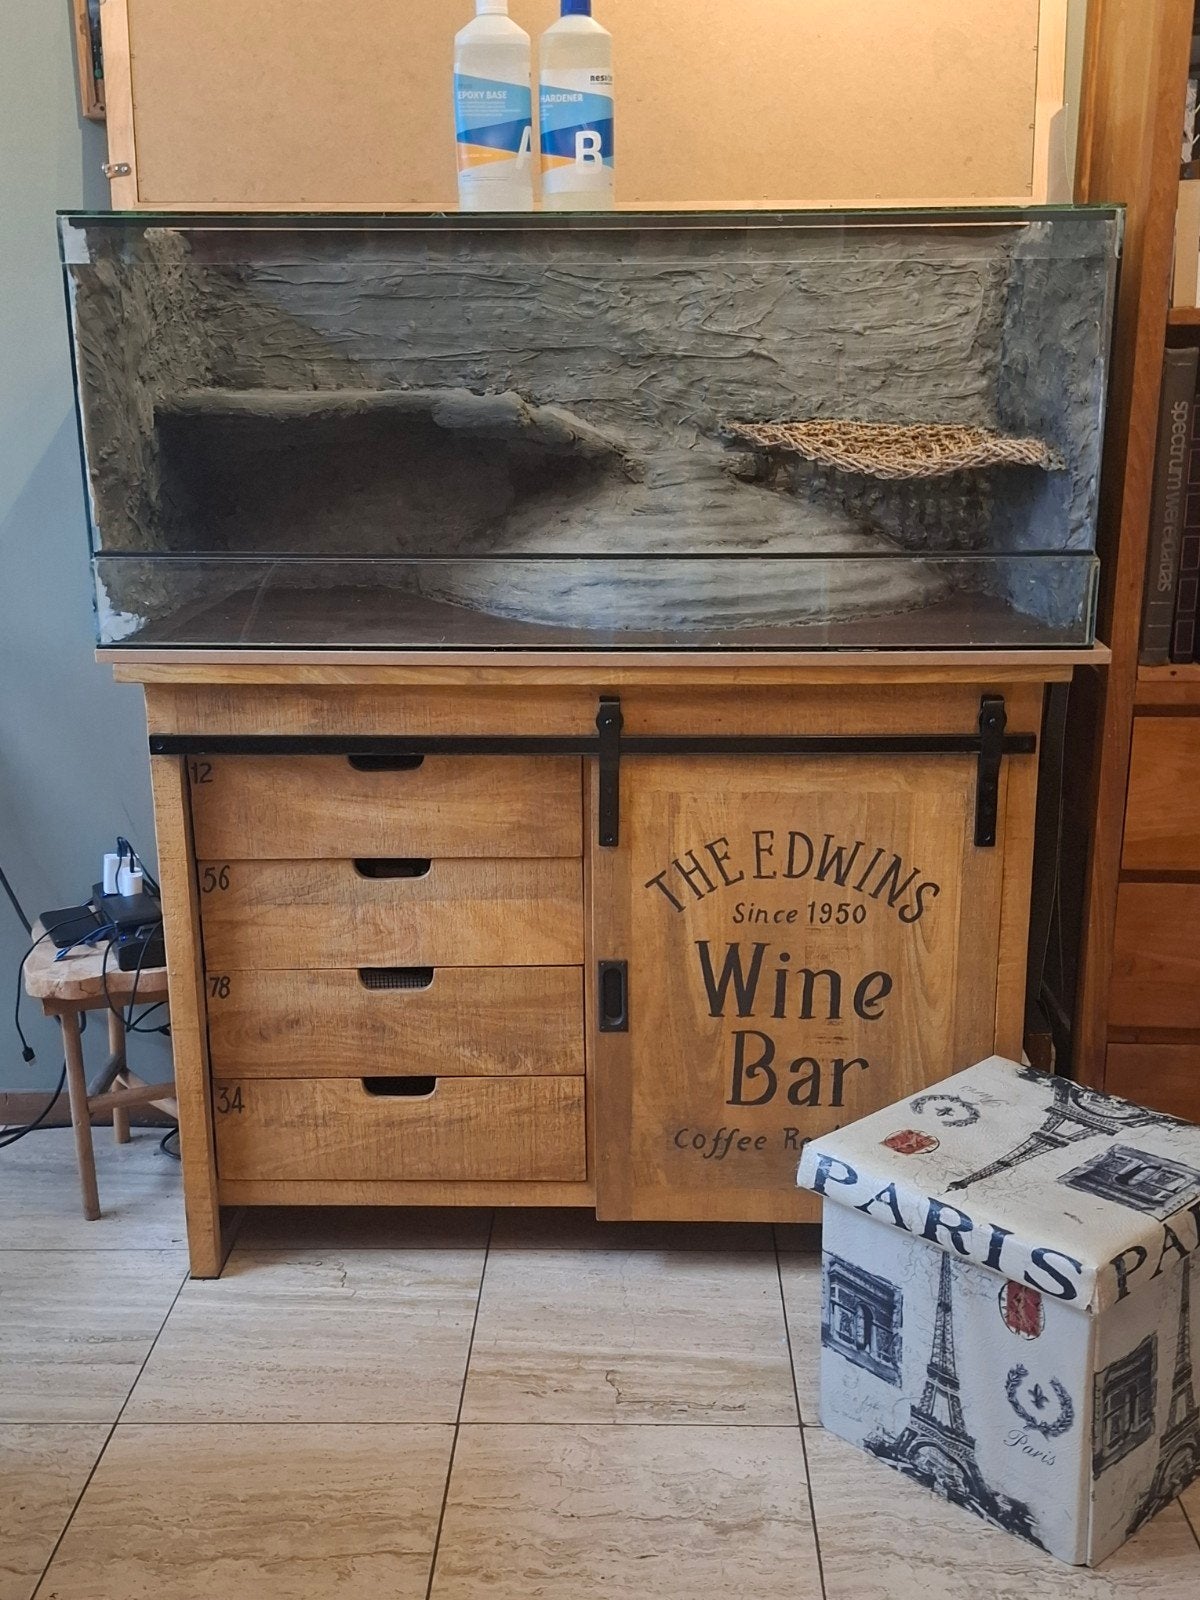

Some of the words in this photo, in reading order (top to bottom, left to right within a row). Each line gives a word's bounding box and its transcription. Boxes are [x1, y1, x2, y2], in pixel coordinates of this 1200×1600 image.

[458, 90, 484, 100] EPOXY
[486, 90, 508, 100] BASE
[575, 130, 603, 175] B
[1166, 400, 1189, 490] spectrum
[190, 762, 213, 785] 12
[202, 864, 231, 893] 56
[644, 836, 745, 913] THE
[751, 830, 941, 924] EDWINS
[732, 902, 799, 924] Since
[807, 901, 867, 925] 1950
[209, 975, 231, 999] 78
[694, 940, 893, 1020] Wine
[726, 1030, 870, 1107] Bar
[217, 1086, 246, 1114] 34
[674, 1127, 768, 1160] Coffee
[809, 1152, 1083, 1301] PARIS
[1109, 1201, 1200, 1304] PA
[1003, 1429, 1056, 1466] Paris
